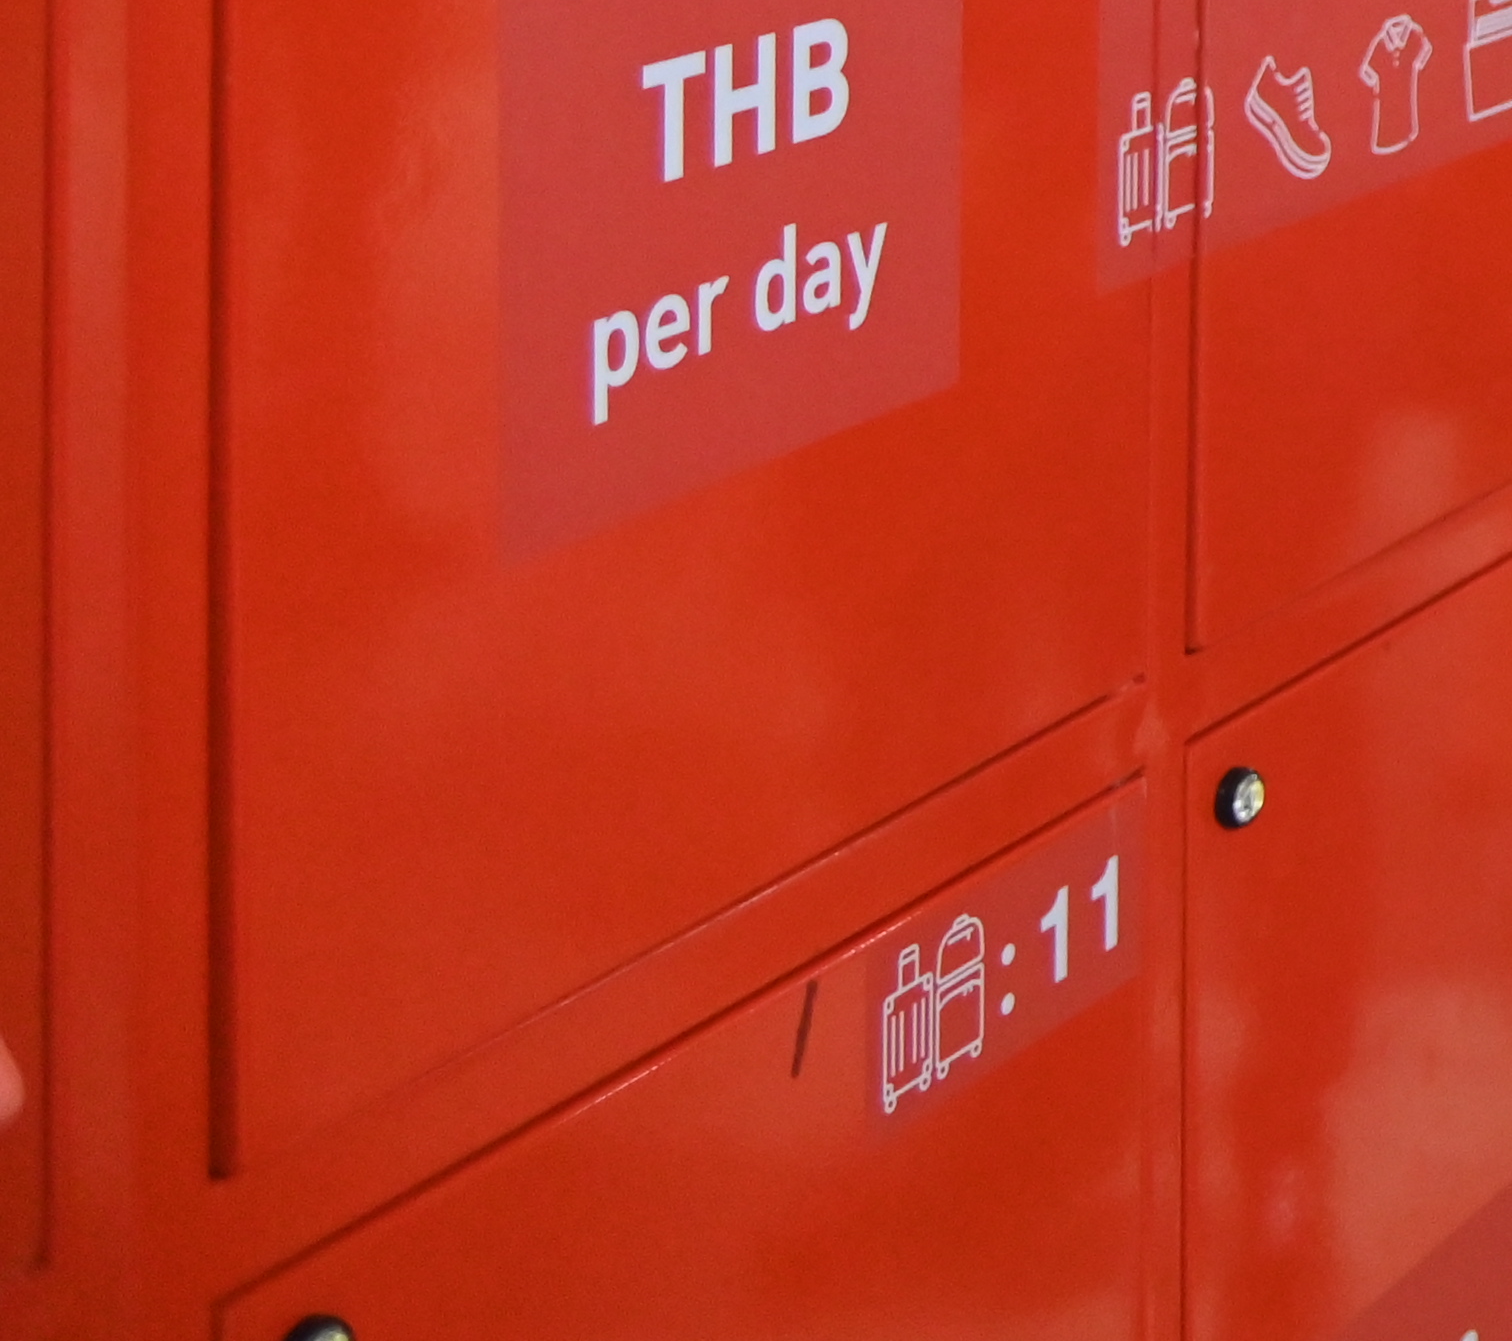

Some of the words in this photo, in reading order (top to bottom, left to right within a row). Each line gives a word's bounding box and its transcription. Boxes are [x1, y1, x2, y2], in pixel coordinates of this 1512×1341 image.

[641, 17, 851, 184] THB
[592, 274, 731, 427] per
[753, 221, 889, 333] day
